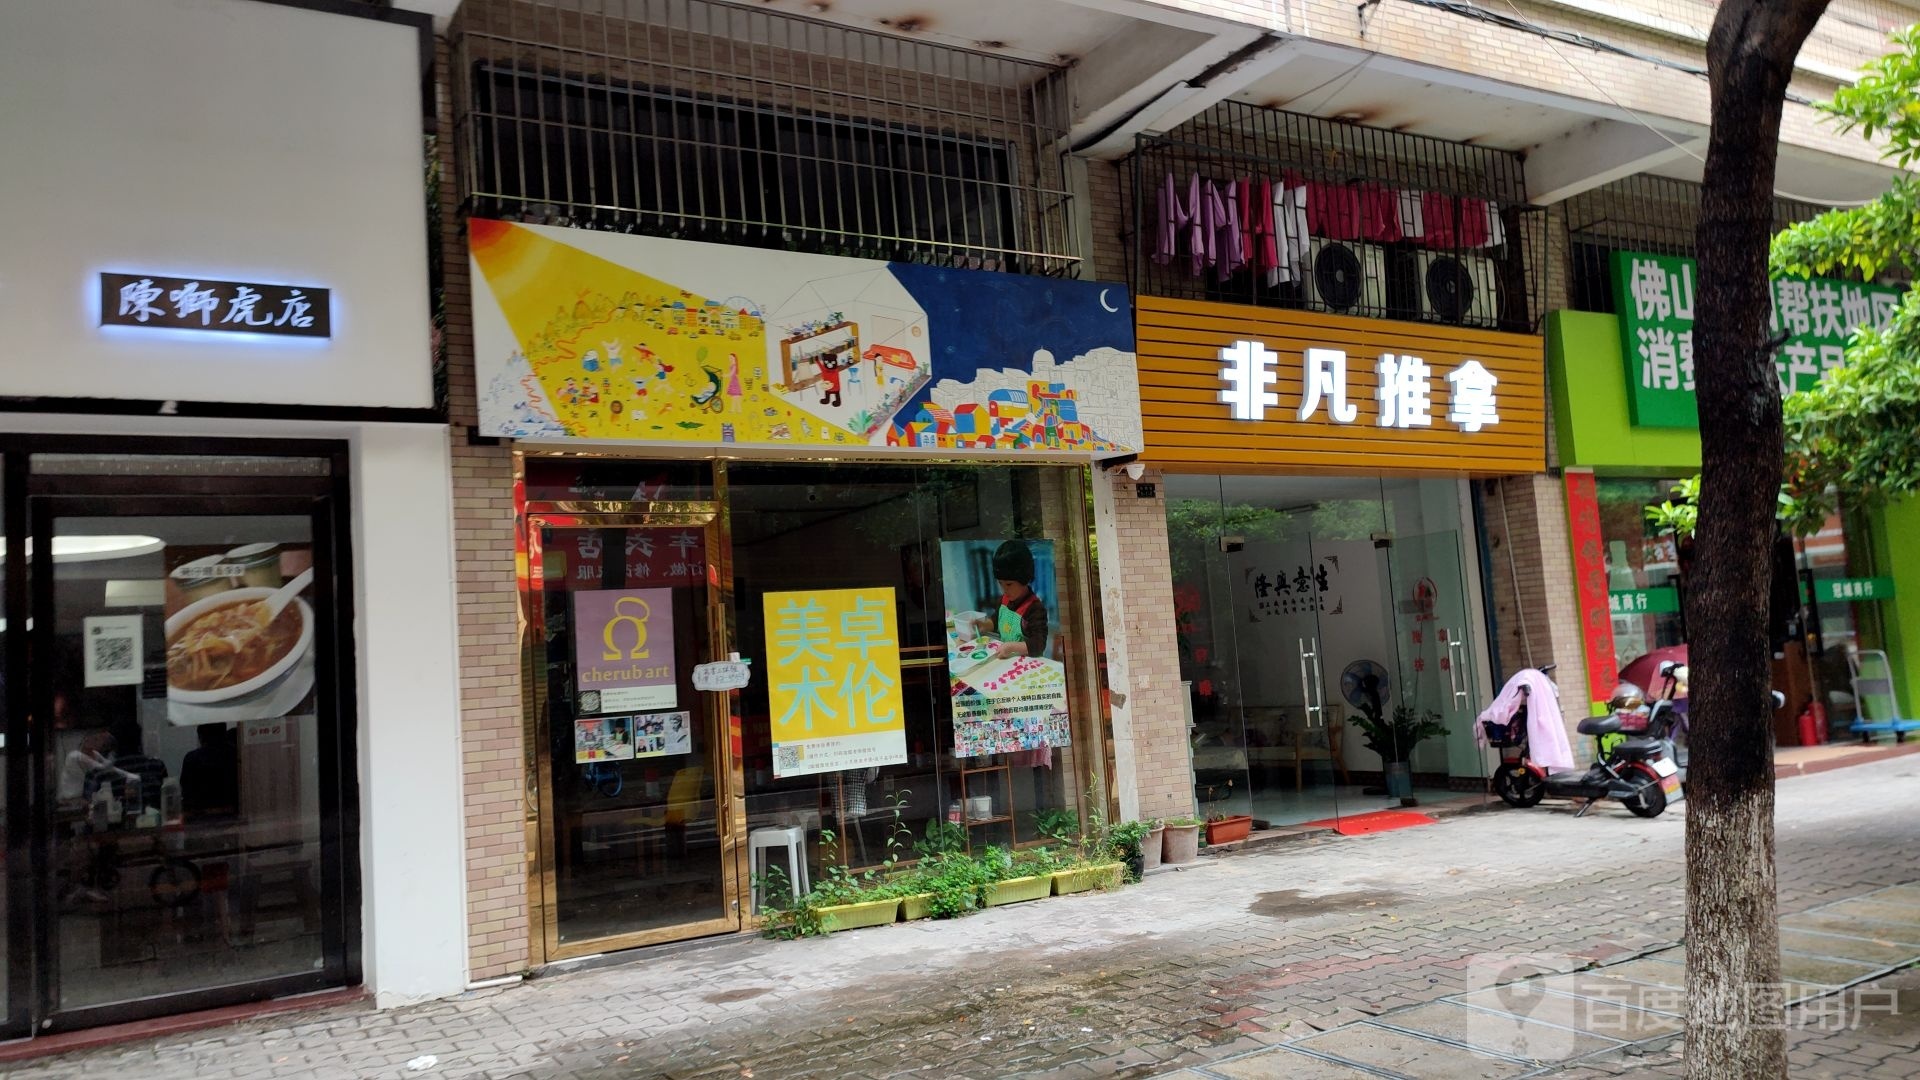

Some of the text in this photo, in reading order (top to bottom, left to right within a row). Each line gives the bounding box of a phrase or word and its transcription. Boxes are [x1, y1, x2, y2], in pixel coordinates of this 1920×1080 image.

[1216, 339, 1501, 433] 非凡推拿
[582, 664, 670, 683] cherub art
